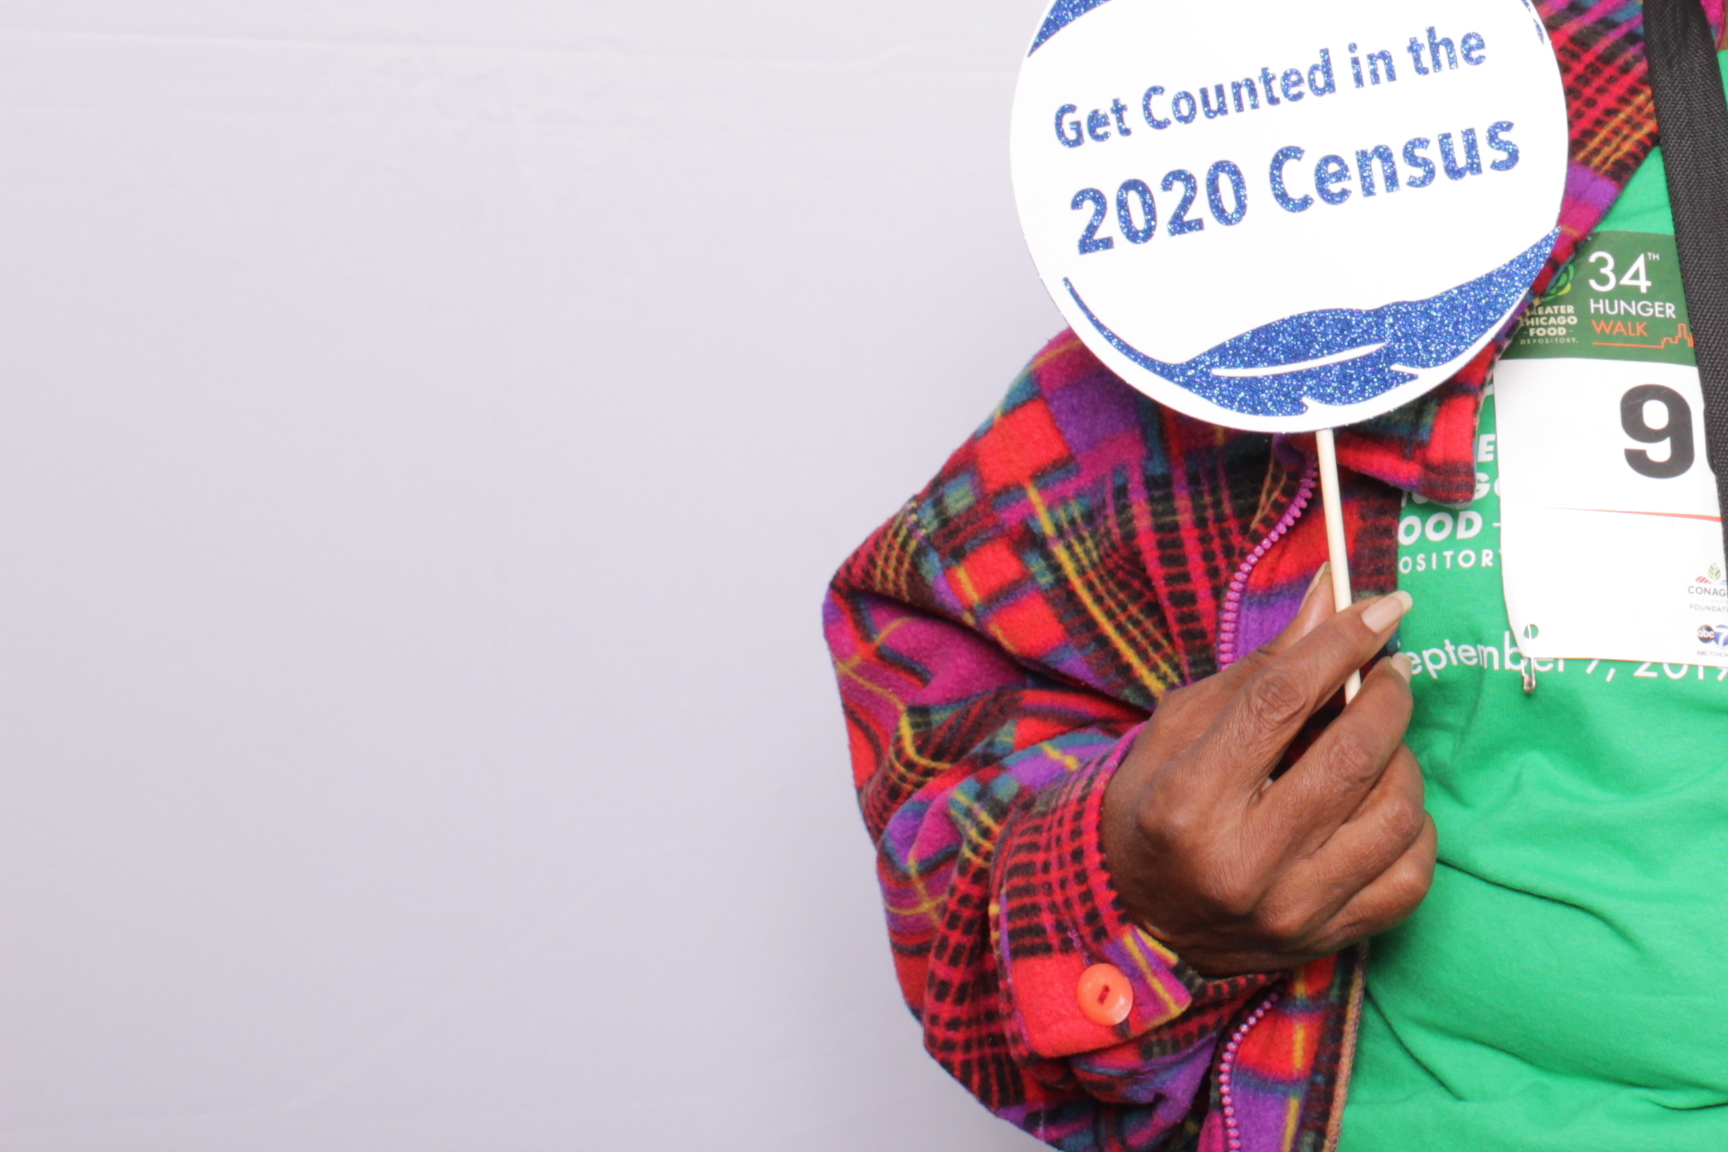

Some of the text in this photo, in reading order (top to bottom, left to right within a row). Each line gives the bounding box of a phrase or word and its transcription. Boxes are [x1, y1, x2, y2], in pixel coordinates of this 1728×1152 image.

[1054, 25, 1486, 148] Get Counted in the
[1070, 120, 1520, 255] 2020 Census
[1533, 305, 1575, 315] EATER
[1590, 298, 1677, 319] HUNGER
[1529, 327, 1567, 337] FOOD
[1592, 319, 1649, 337] WALK
[1398, 510, 1483, 546] OOD
[1398, 549, 1501, 574] OSITOR
[1687, 585, 1727, 598] CONAG
